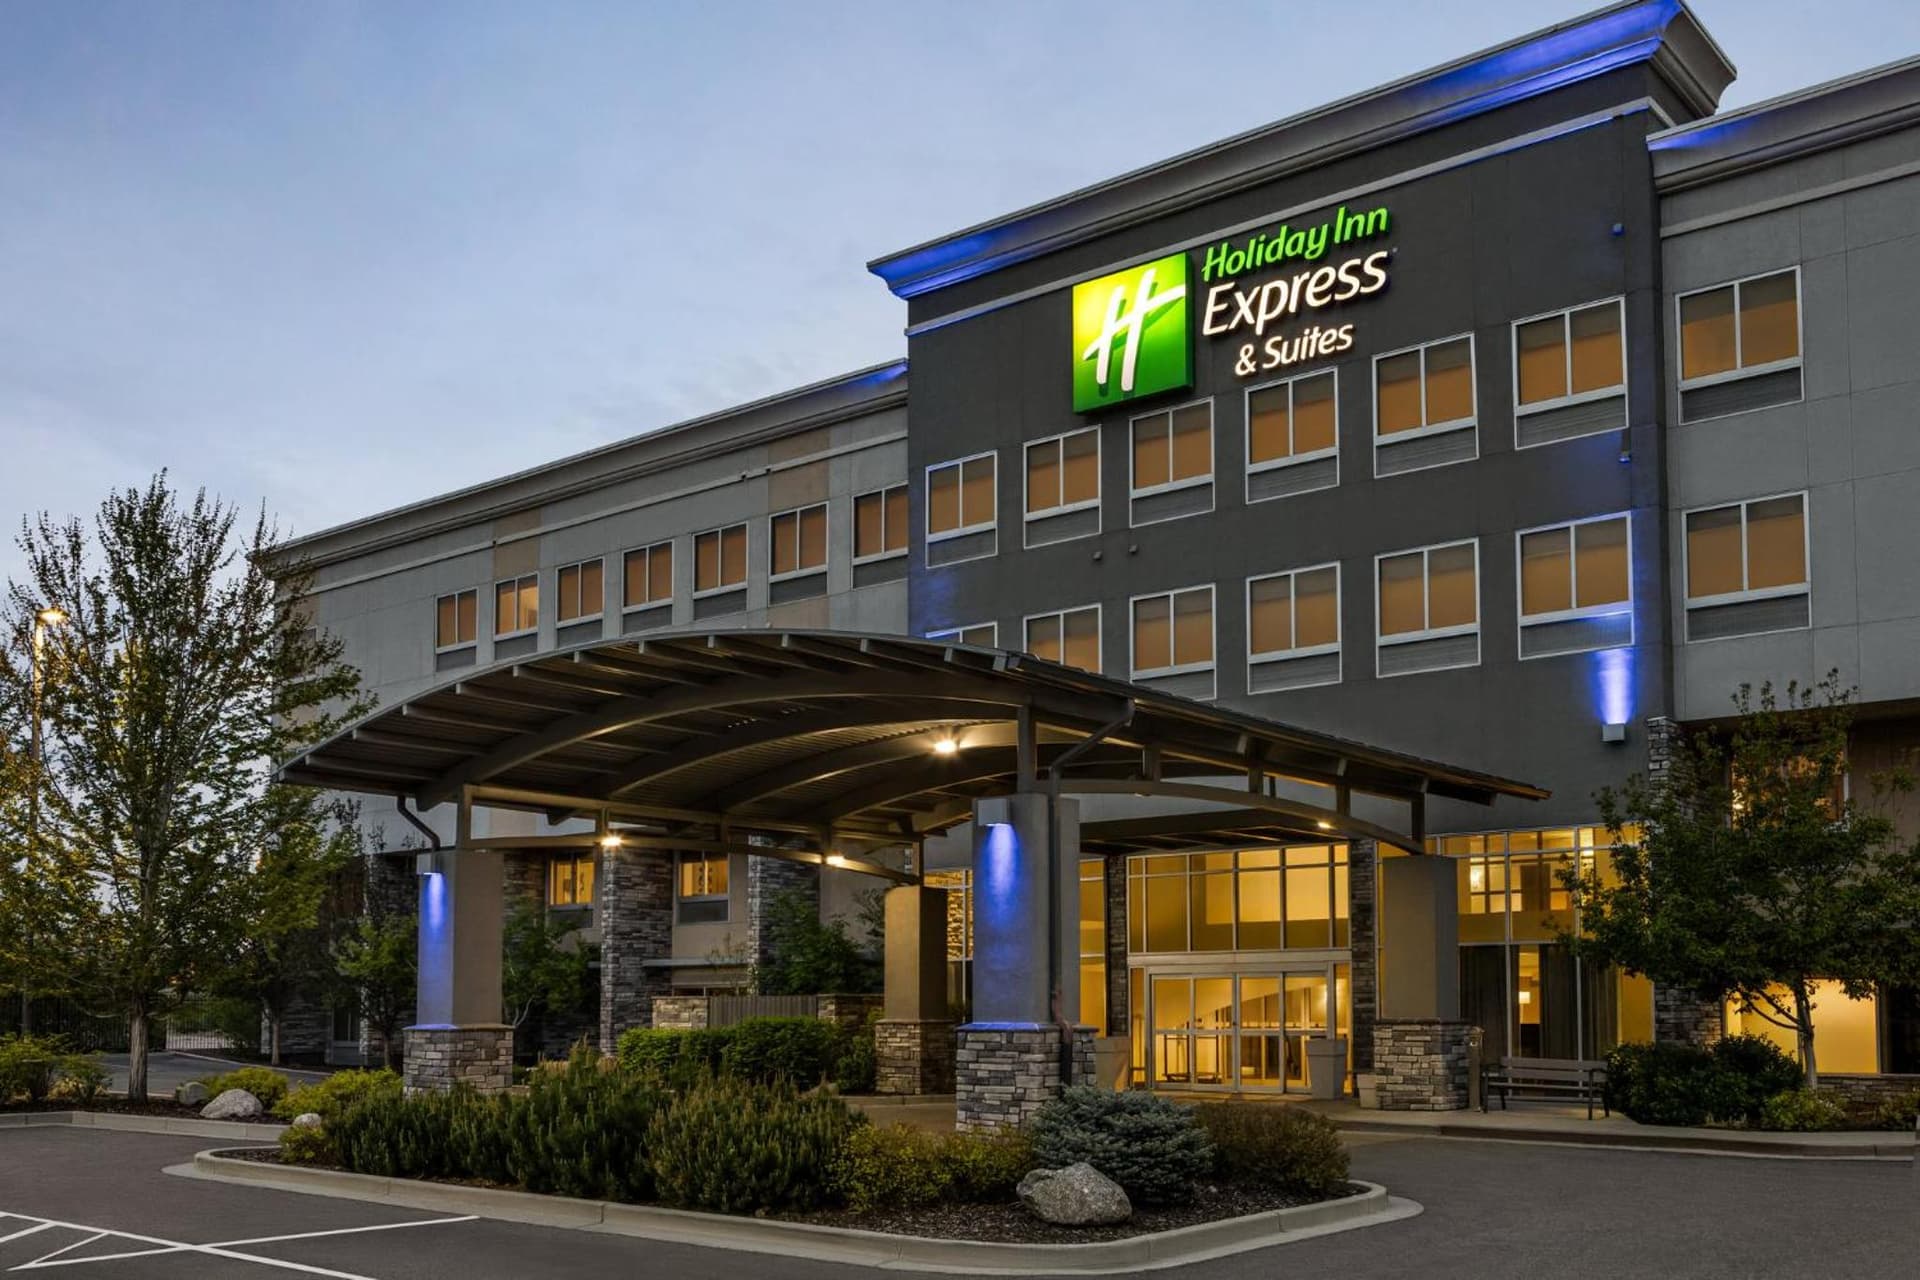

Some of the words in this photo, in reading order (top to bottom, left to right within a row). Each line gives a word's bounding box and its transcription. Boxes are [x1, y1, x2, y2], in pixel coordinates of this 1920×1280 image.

[1201, 224, 1328, 282] Holiday
[1333, 206, 1388, 244] Inn
[1202, 250, 1388, 336] Express
[1234, 344, 1256, 376] &
[1263, 324, 1353, 369] Suites
